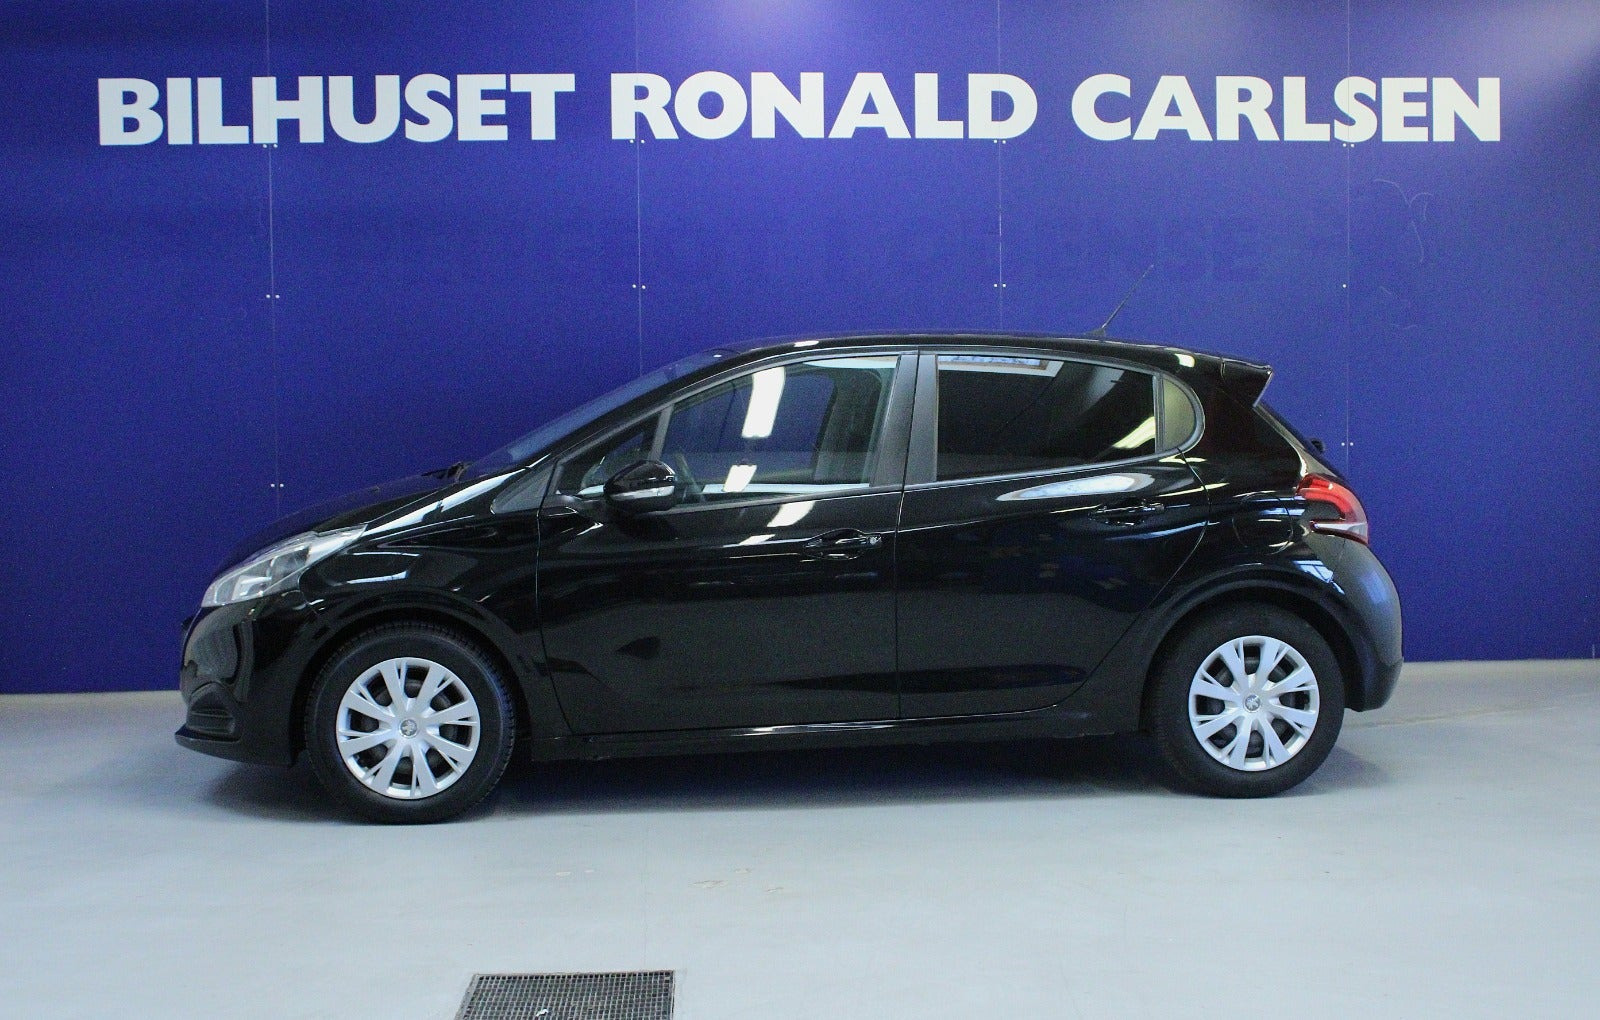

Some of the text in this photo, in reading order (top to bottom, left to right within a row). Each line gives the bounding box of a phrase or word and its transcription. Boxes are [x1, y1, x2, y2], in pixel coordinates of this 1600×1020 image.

[98, 71, 1501, 146] BILHUSET RONALD CARLSEN
